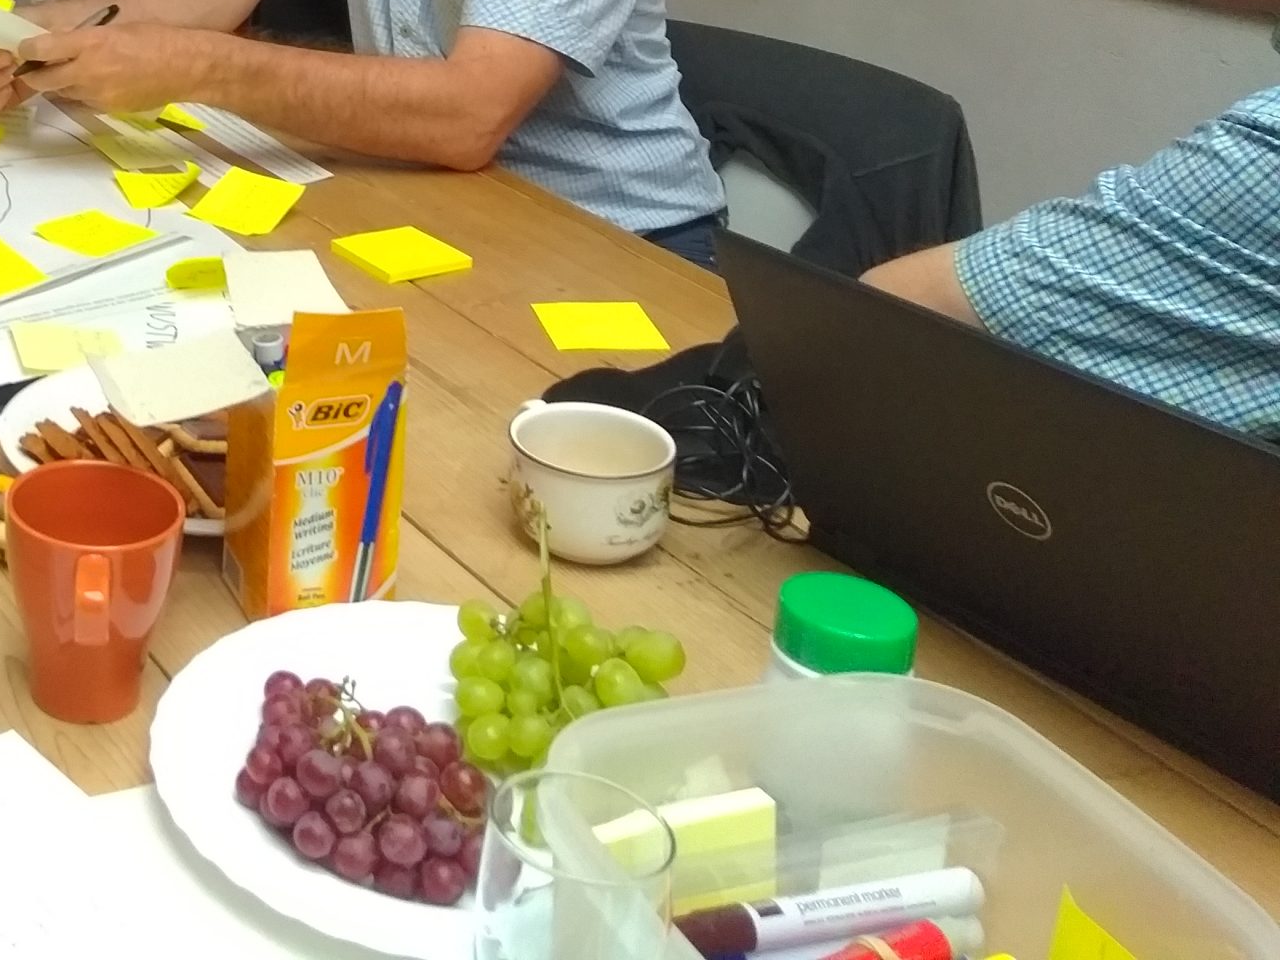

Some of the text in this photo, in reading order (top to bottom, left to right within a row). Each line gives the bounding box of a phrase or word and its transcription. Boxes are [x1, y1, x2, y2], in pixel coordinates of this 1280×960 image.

[334, 341, 372, 366] M
[993, 494, 1046, 529] DELL
[797, 891, 861, 914] permanent
[862, 887, 902, 904] marker
